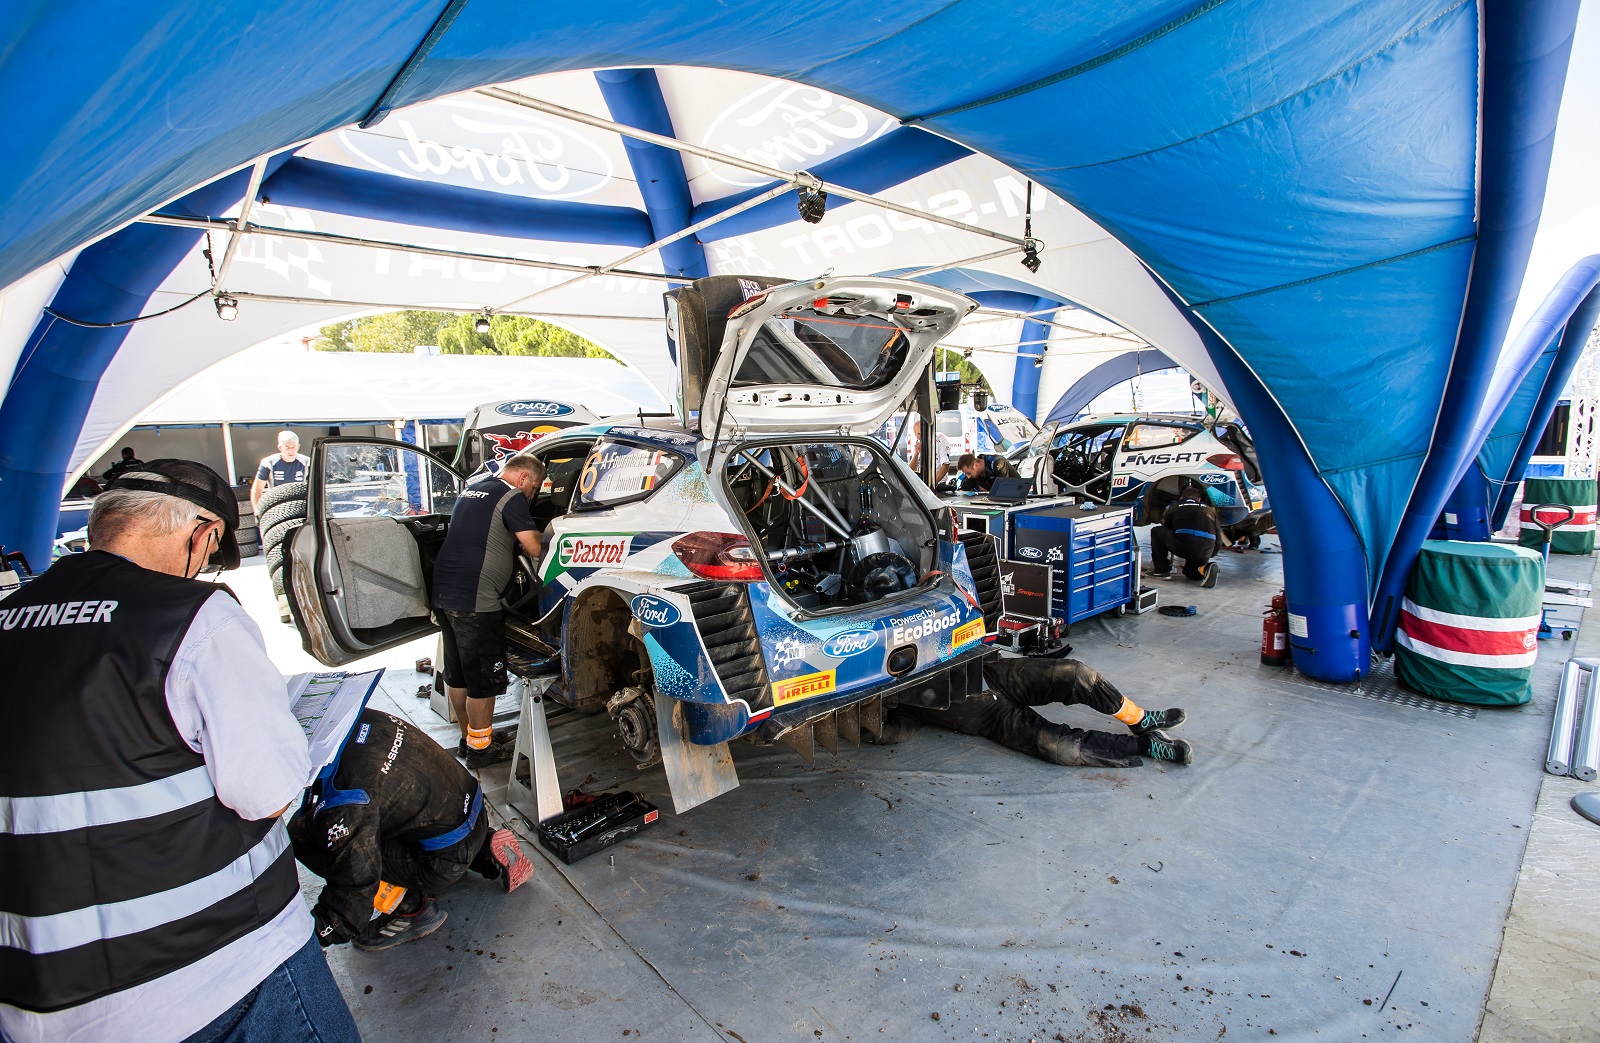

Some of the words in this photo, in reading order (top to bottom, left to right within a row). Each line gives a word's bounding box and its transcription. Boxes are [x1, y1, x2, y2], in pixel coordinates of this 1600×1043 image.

[510, 402, 560, 415] Ford
[1135, 451, 1208, 466] MS-RT
[579, 452, 602, 494] 6
[1203, 474, 1226, 485] Ford
[572, 540, 626, 564] Castrol
[1022, 548, 1039, 557] Ford
[1017, 588, 1045, 597] Snap-on
[637, 597, 669, 624] Ford
[889, 610, 926, 628] Powered
[926, 608, 936, 620] by
[892, 610, 962, 646] EcoBoost
[953, 621, 983, 645] PIRELLI
[832, 630, 870, 655] Ford
[777, 674, 831, 700] PIRELLI
